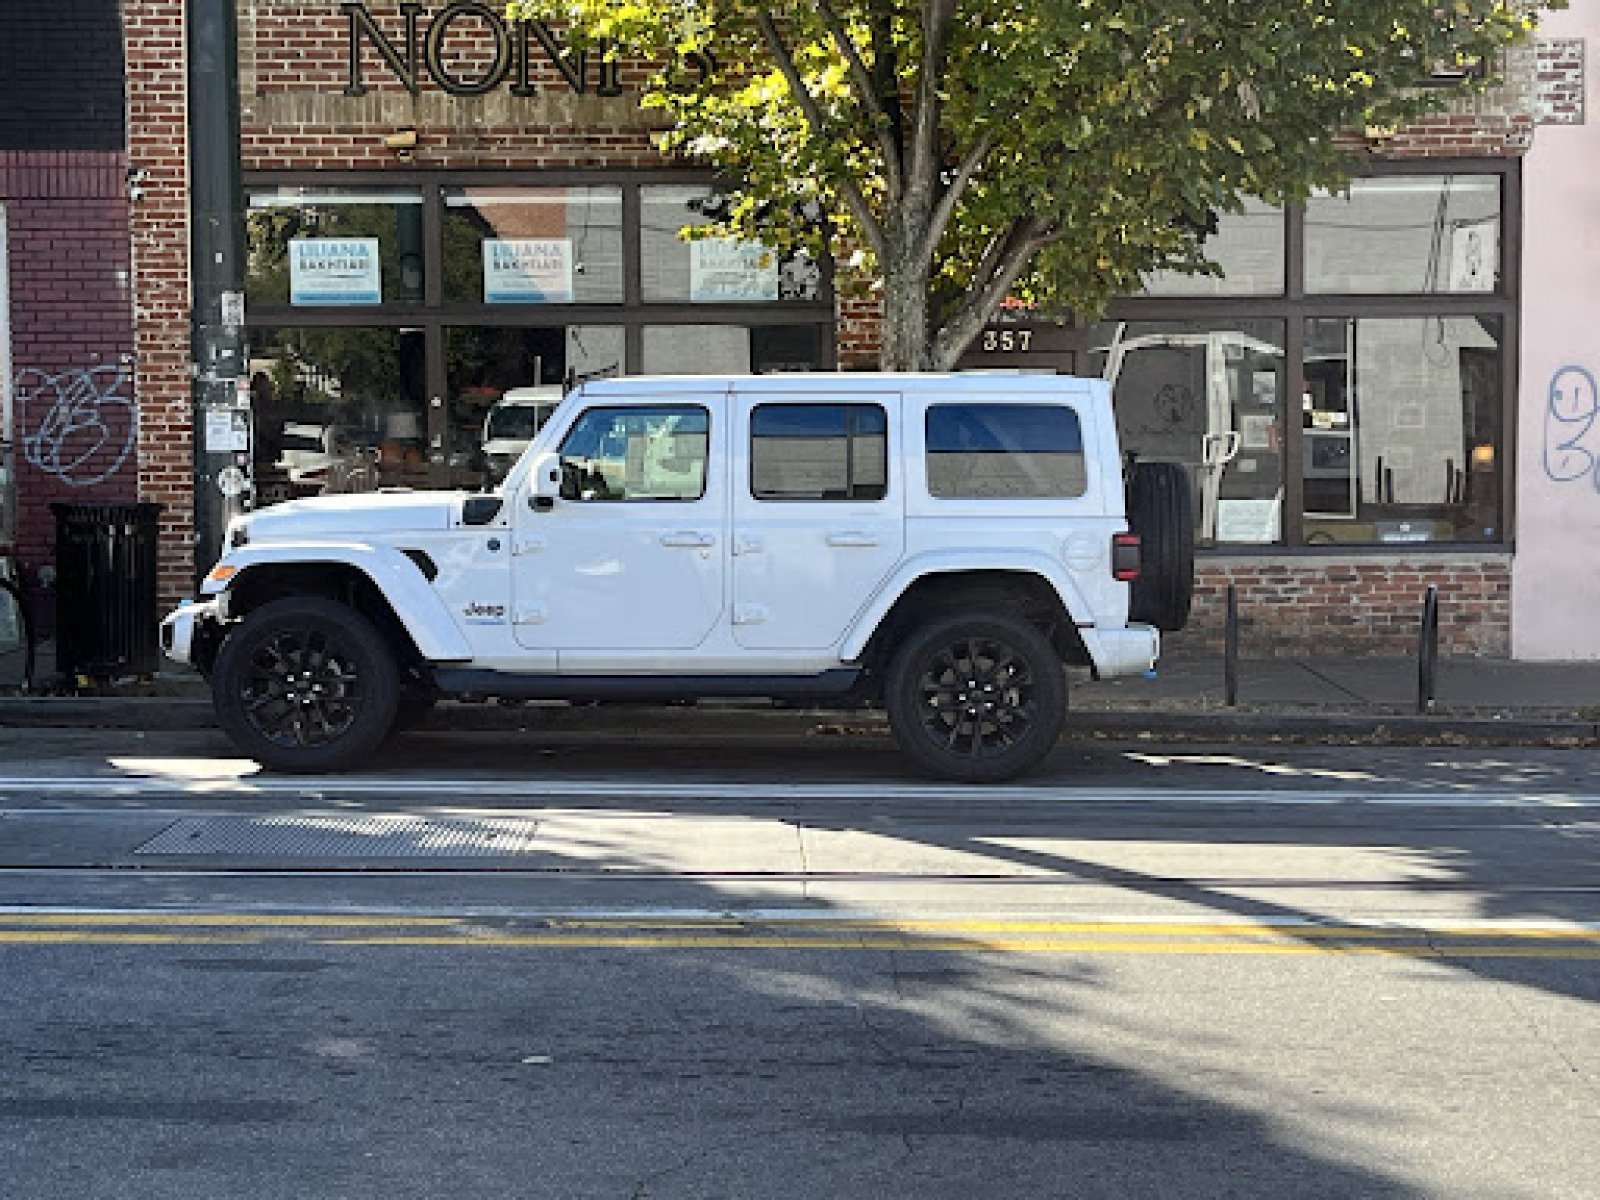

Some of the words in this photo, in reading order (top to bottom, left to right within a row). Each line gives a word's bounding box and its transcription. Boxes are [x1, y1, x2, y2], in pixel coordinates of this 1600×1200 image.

[340, 2, 717, 97] NONI
[983, 331, 1032, 350] 357
[462, 601, 506, 619] Jeep
